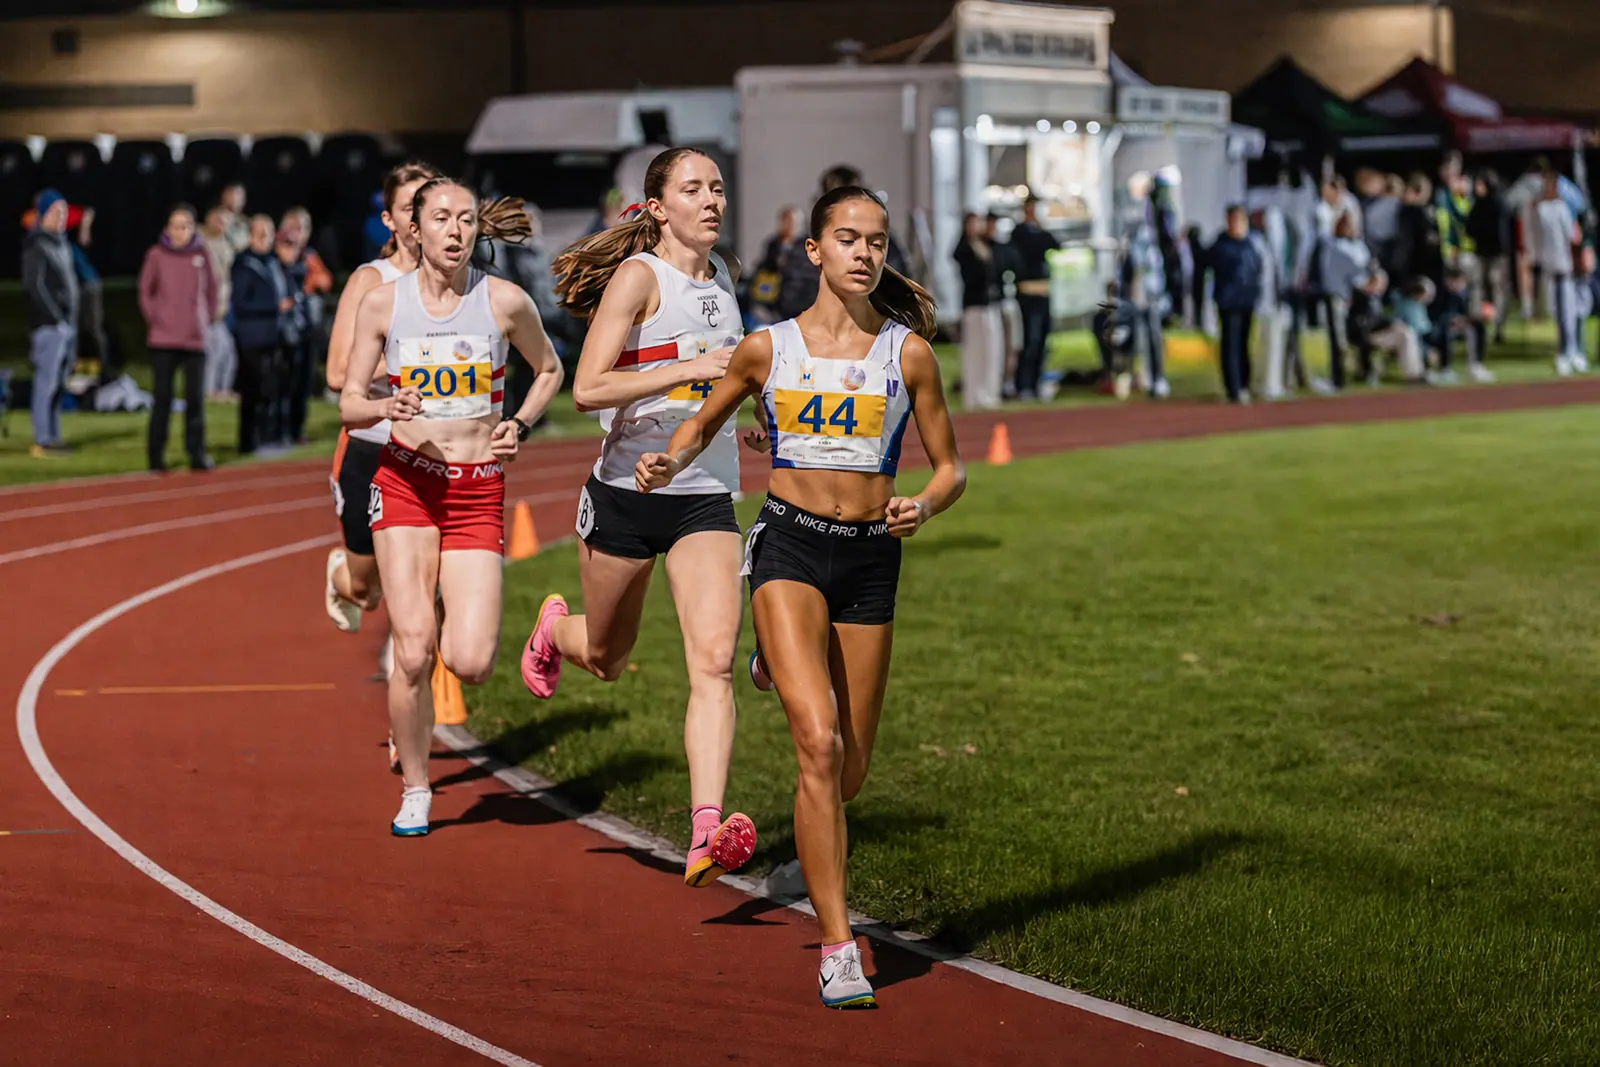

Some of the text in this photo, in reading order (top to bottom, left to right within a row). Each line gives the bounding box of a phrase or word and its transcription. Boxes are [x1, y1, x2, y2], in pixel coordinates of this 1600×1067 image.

[410, 365, 476, 397] 201
[798, 394, 858, 435] 44
[386, 443, 504, 479] KE PRO NIK
[764, 498, 889, 538] PRO NIKE PRO NIK
